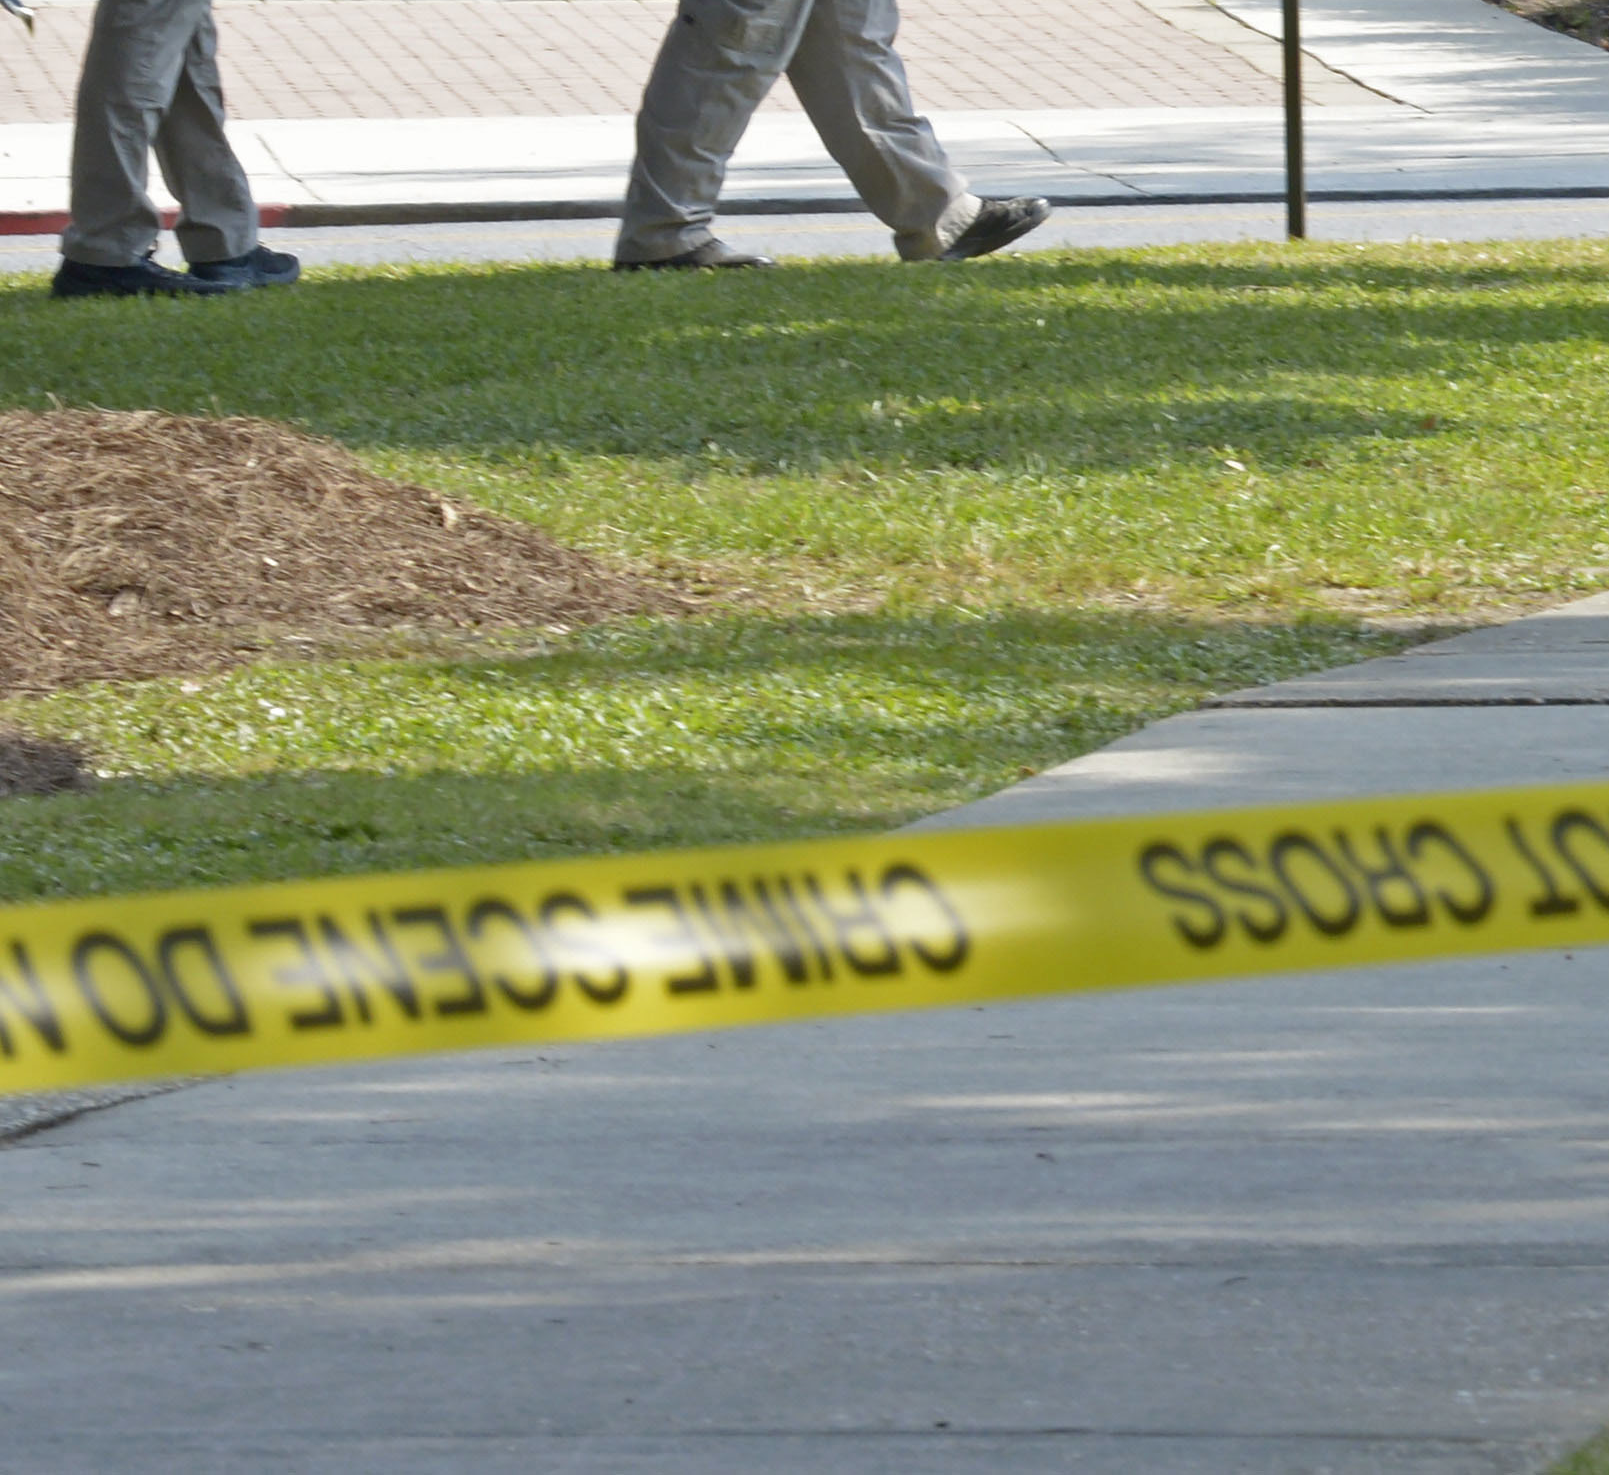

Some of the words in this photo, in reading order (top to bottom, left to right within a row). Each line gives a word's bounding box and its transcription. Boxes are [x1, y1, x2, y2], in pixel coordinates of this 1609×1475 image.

[624, 861, 974, 997] CRIME
[1136, 815, 1499, 951] CROSS
[72, 928, 255, 1050] DO
[247, 891, 630, 1033] SCENE
